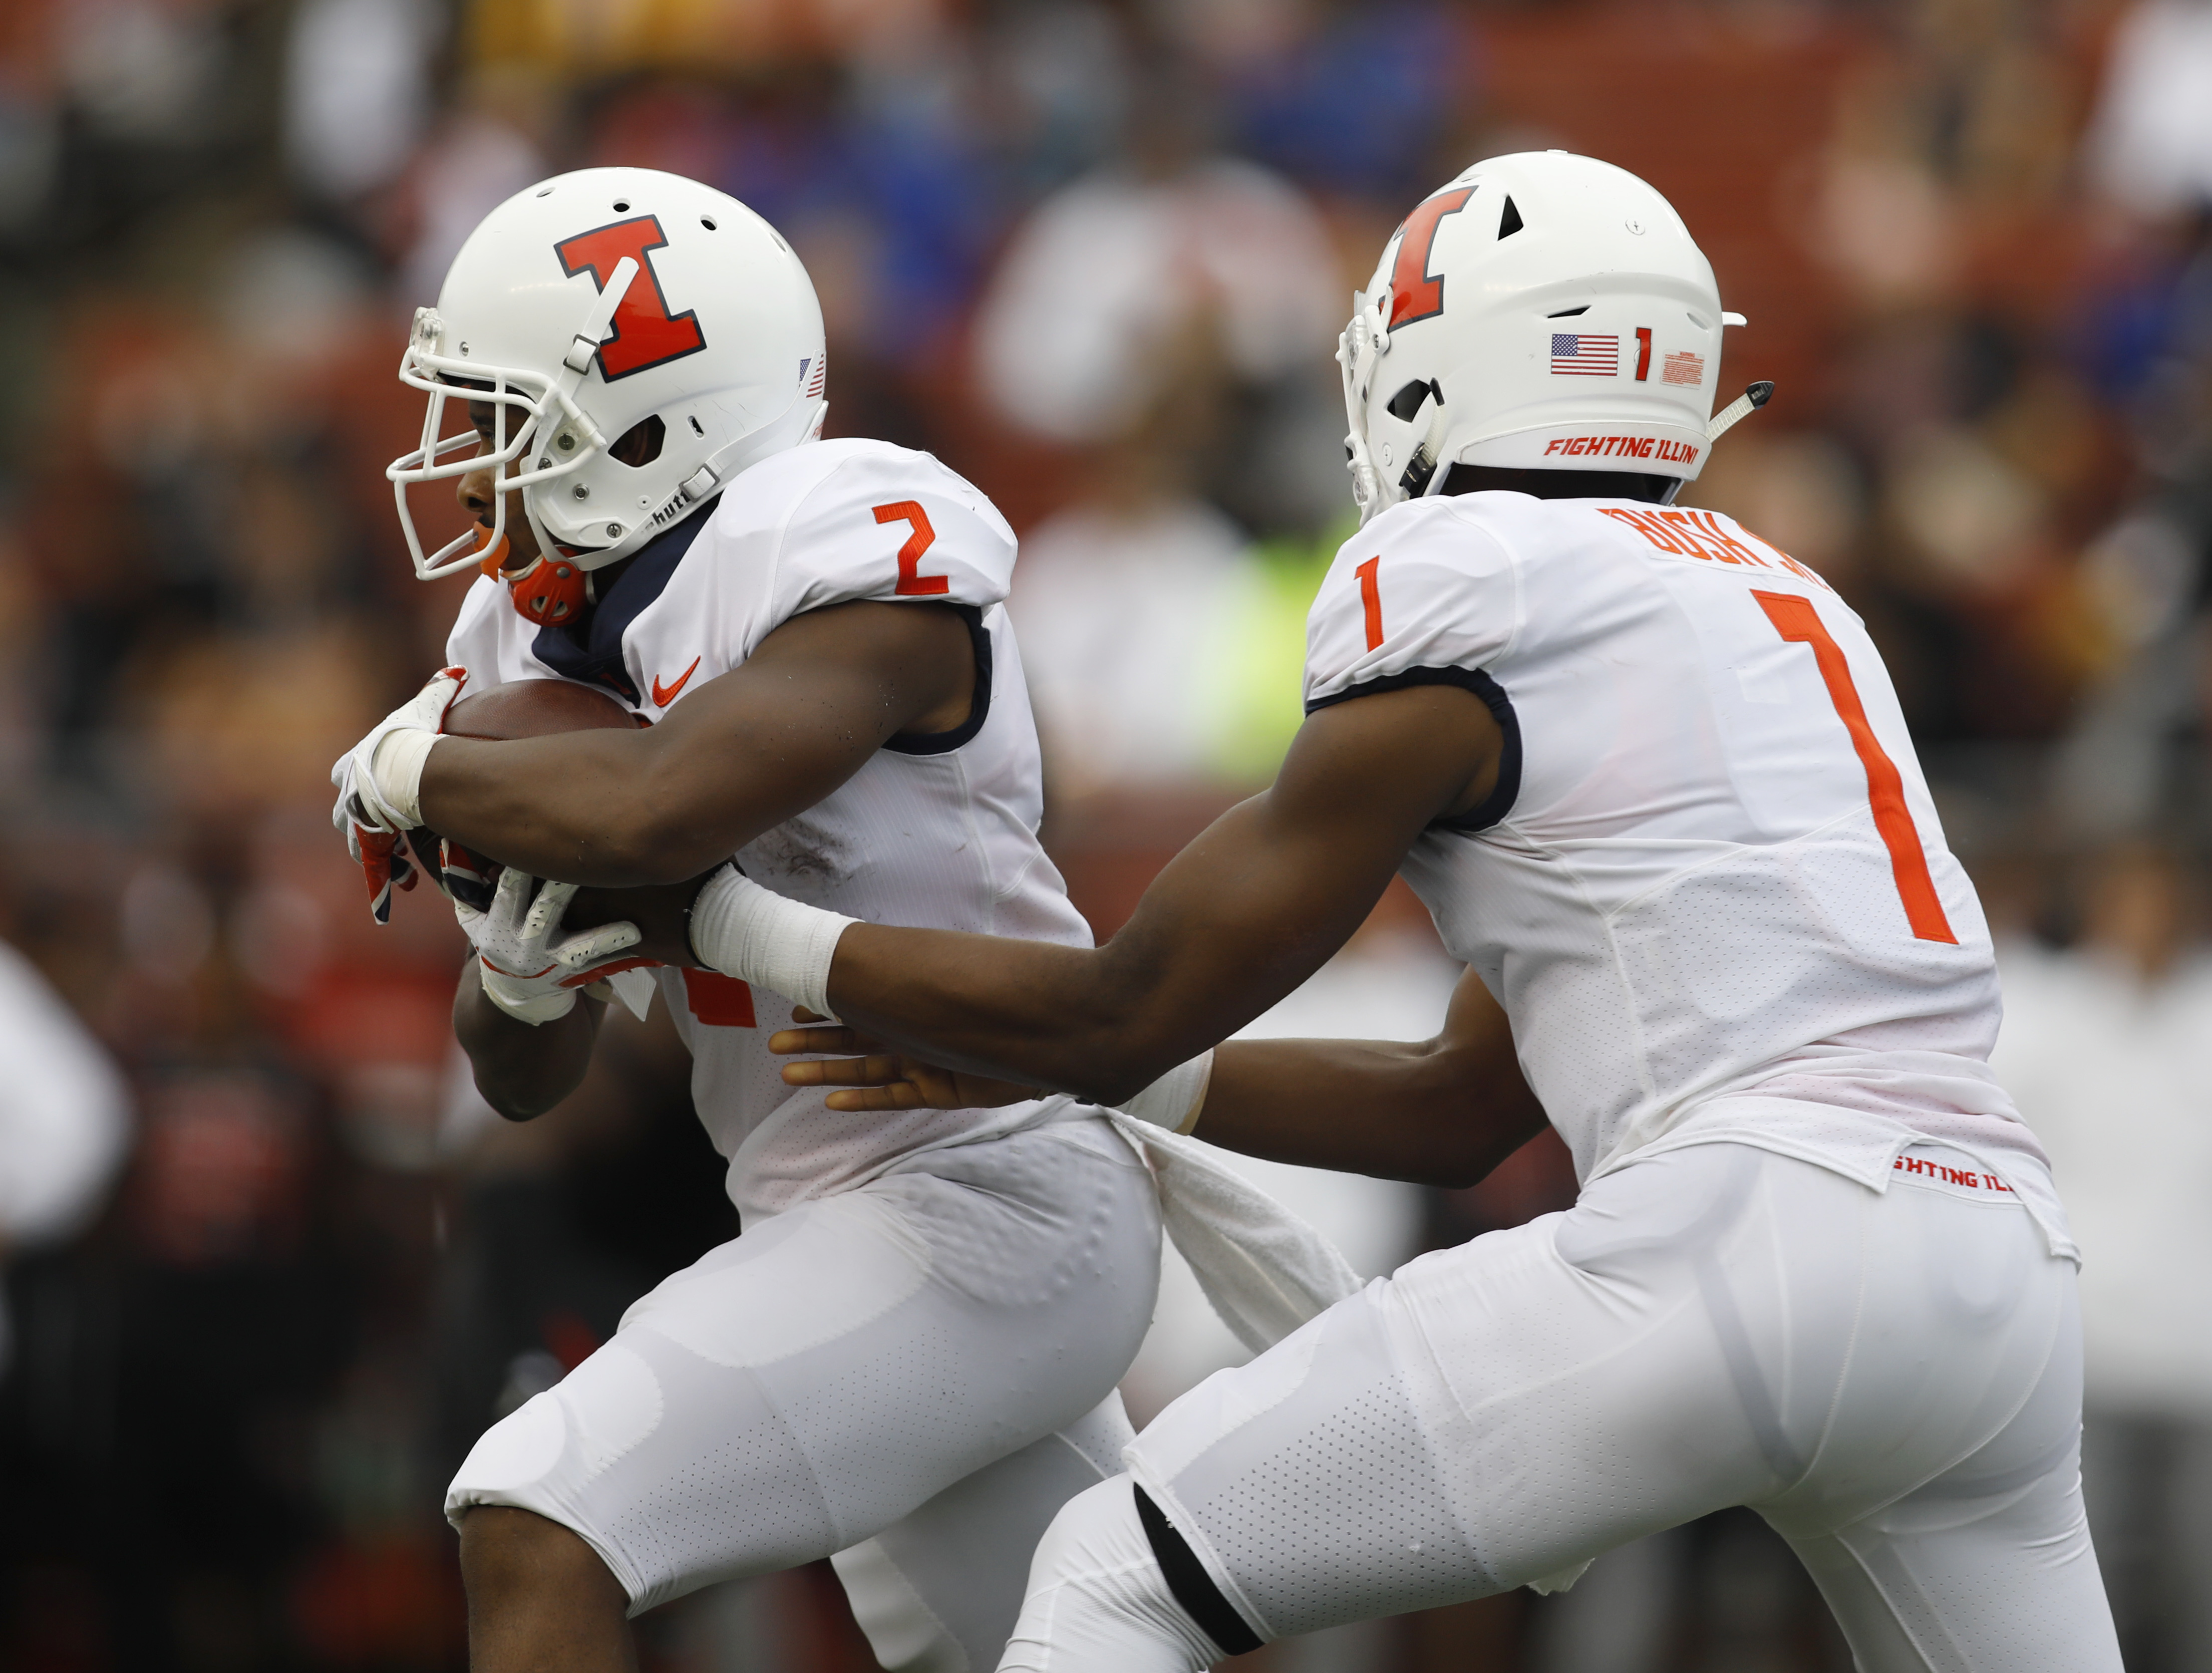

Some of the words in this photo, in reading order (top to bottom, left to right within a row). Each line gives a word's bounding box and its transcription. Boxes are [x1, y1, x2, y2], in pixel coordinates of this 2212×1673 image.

[554, 214, 707, 383] I
[1378, 185, 1479, 333] I
[1636, 327, 1652, 381] 1
[1544, 437, 1656, 458] FIGHTING
[1655, 439, 1699, 465] ILLINI
[871, 500, 950, 595] 2
[1596, 508, 1773, 568] BUSH
[1354, 555, 1384, 653] 1
[1749, 588, 1959, 945] 1
[1894, 1156, 1978, 1188] GHTING
